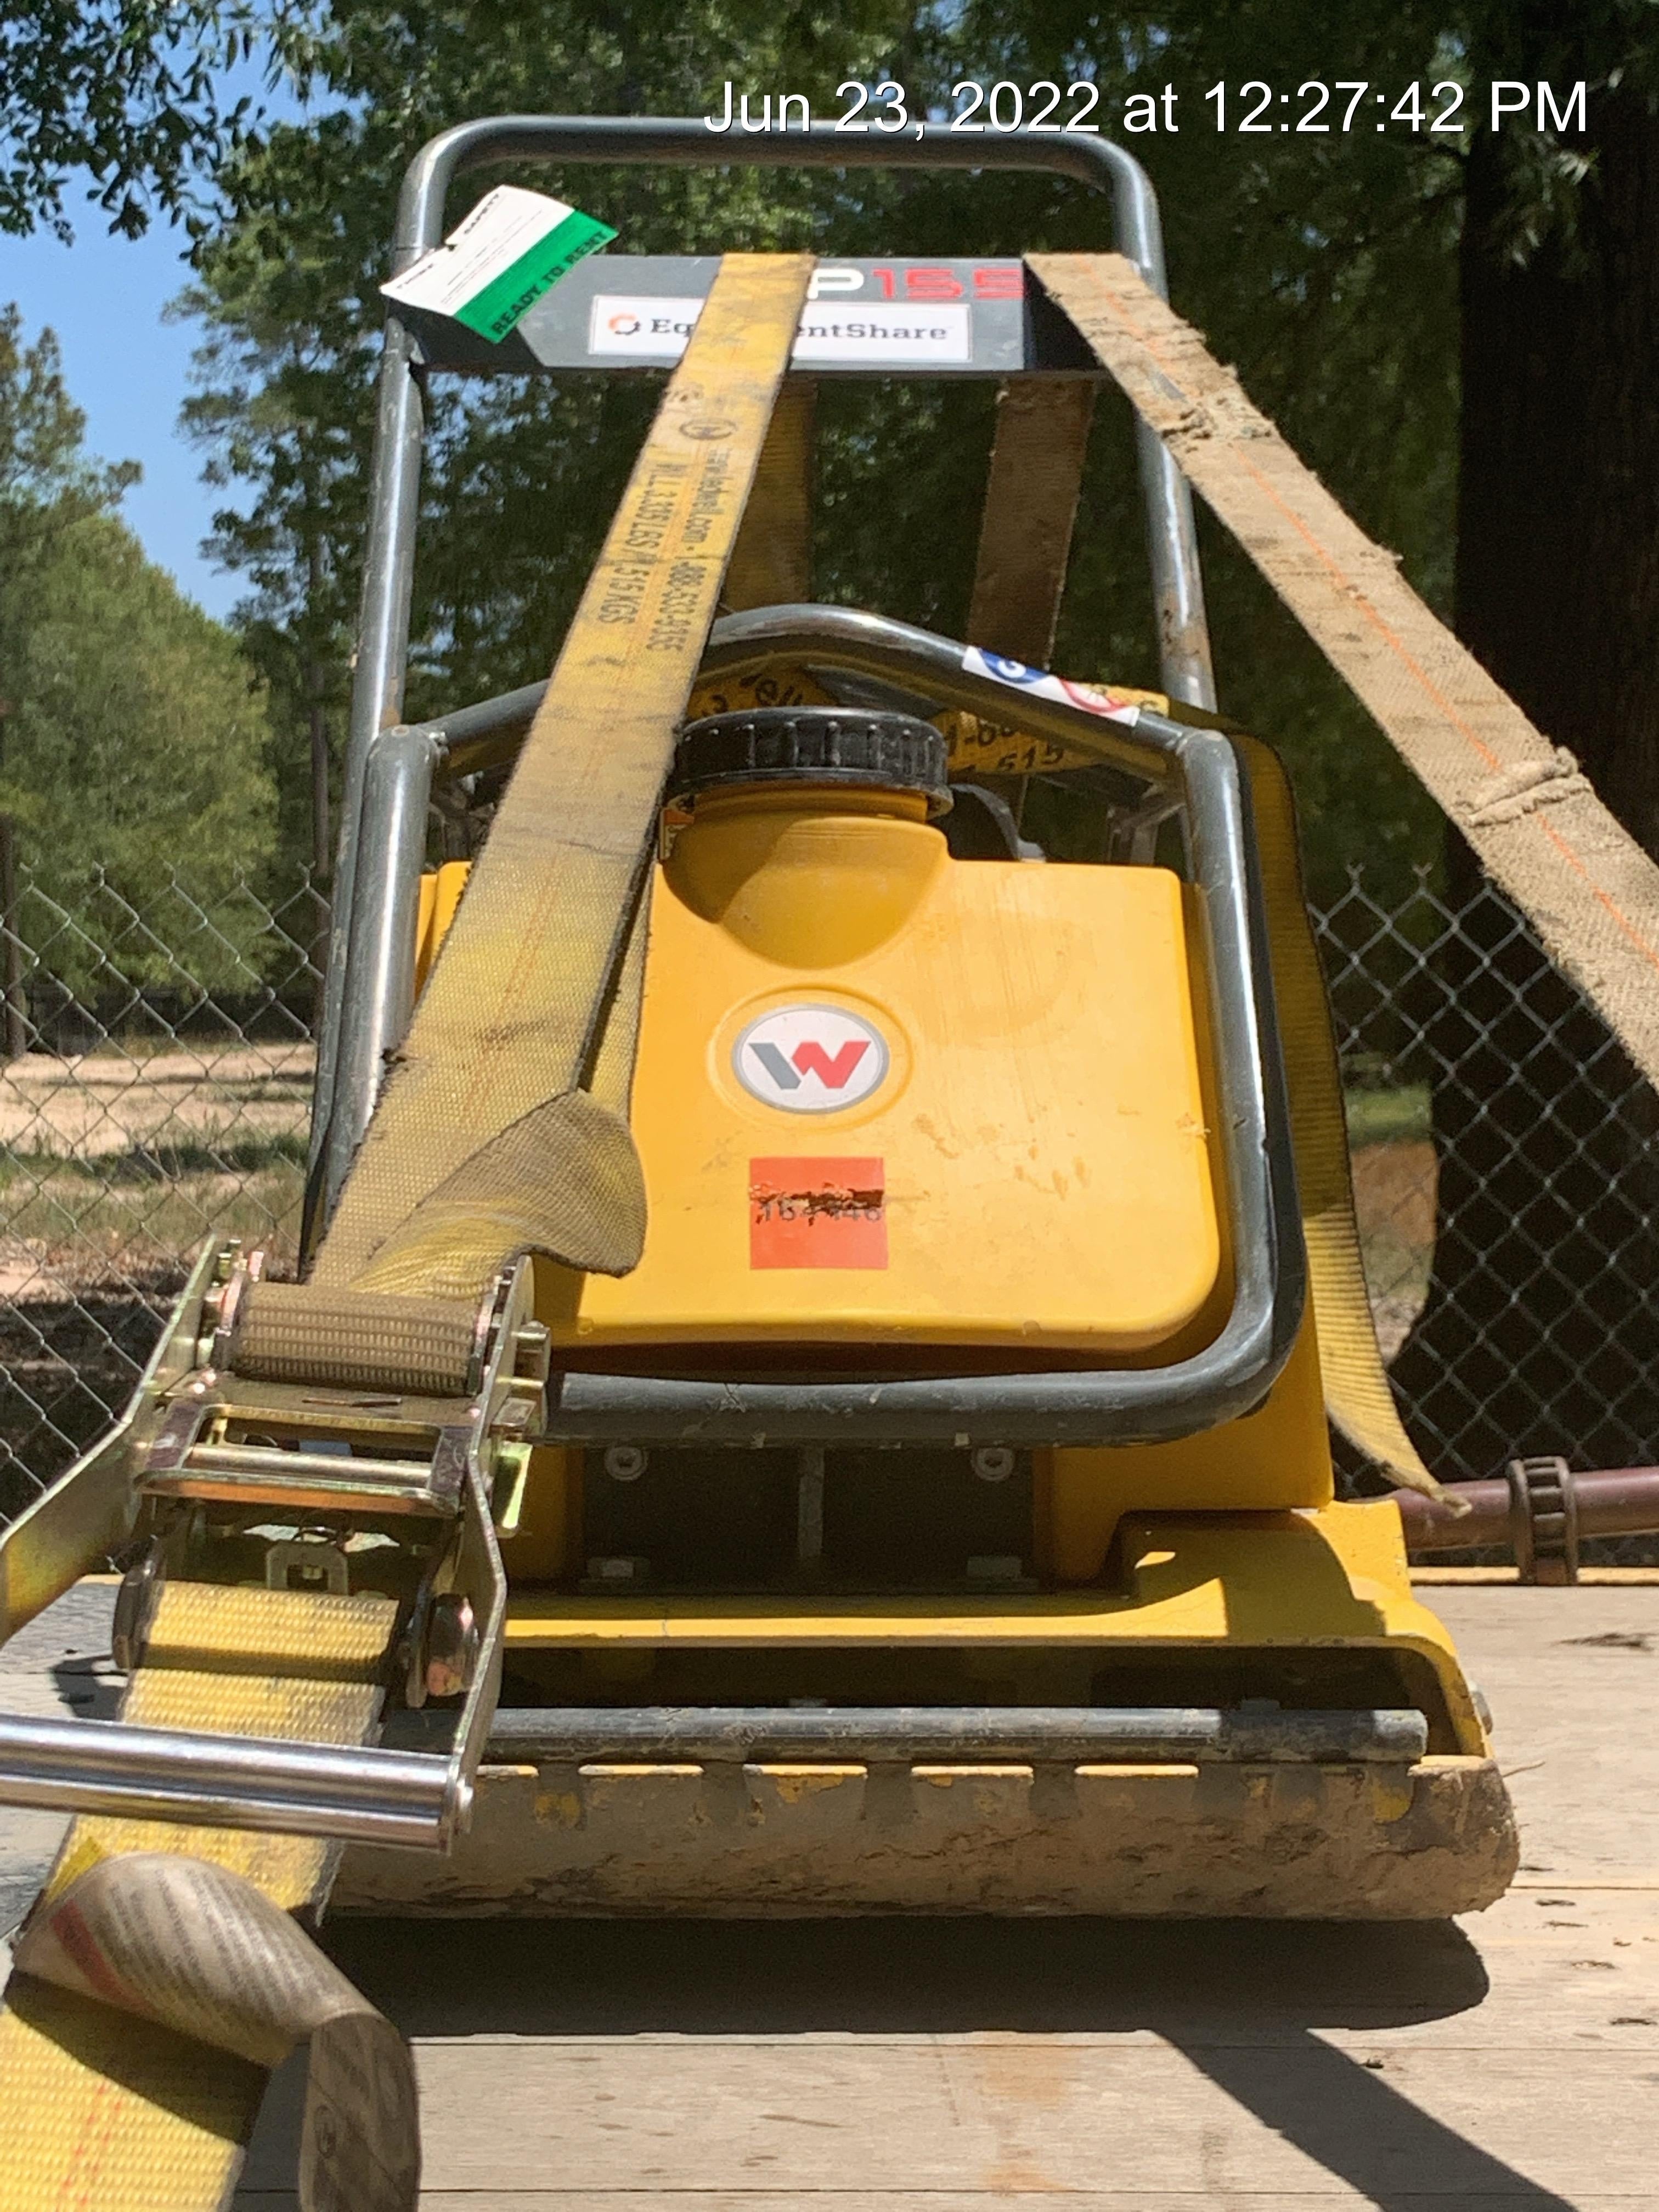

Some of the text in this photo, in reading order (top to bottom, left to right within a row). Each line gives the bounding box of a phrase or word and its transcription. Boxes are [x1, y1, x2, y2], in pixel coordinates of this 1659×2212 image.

[491, 230, 607, 335] READY TO RENT
[597, 591, 643, 624] KGS
